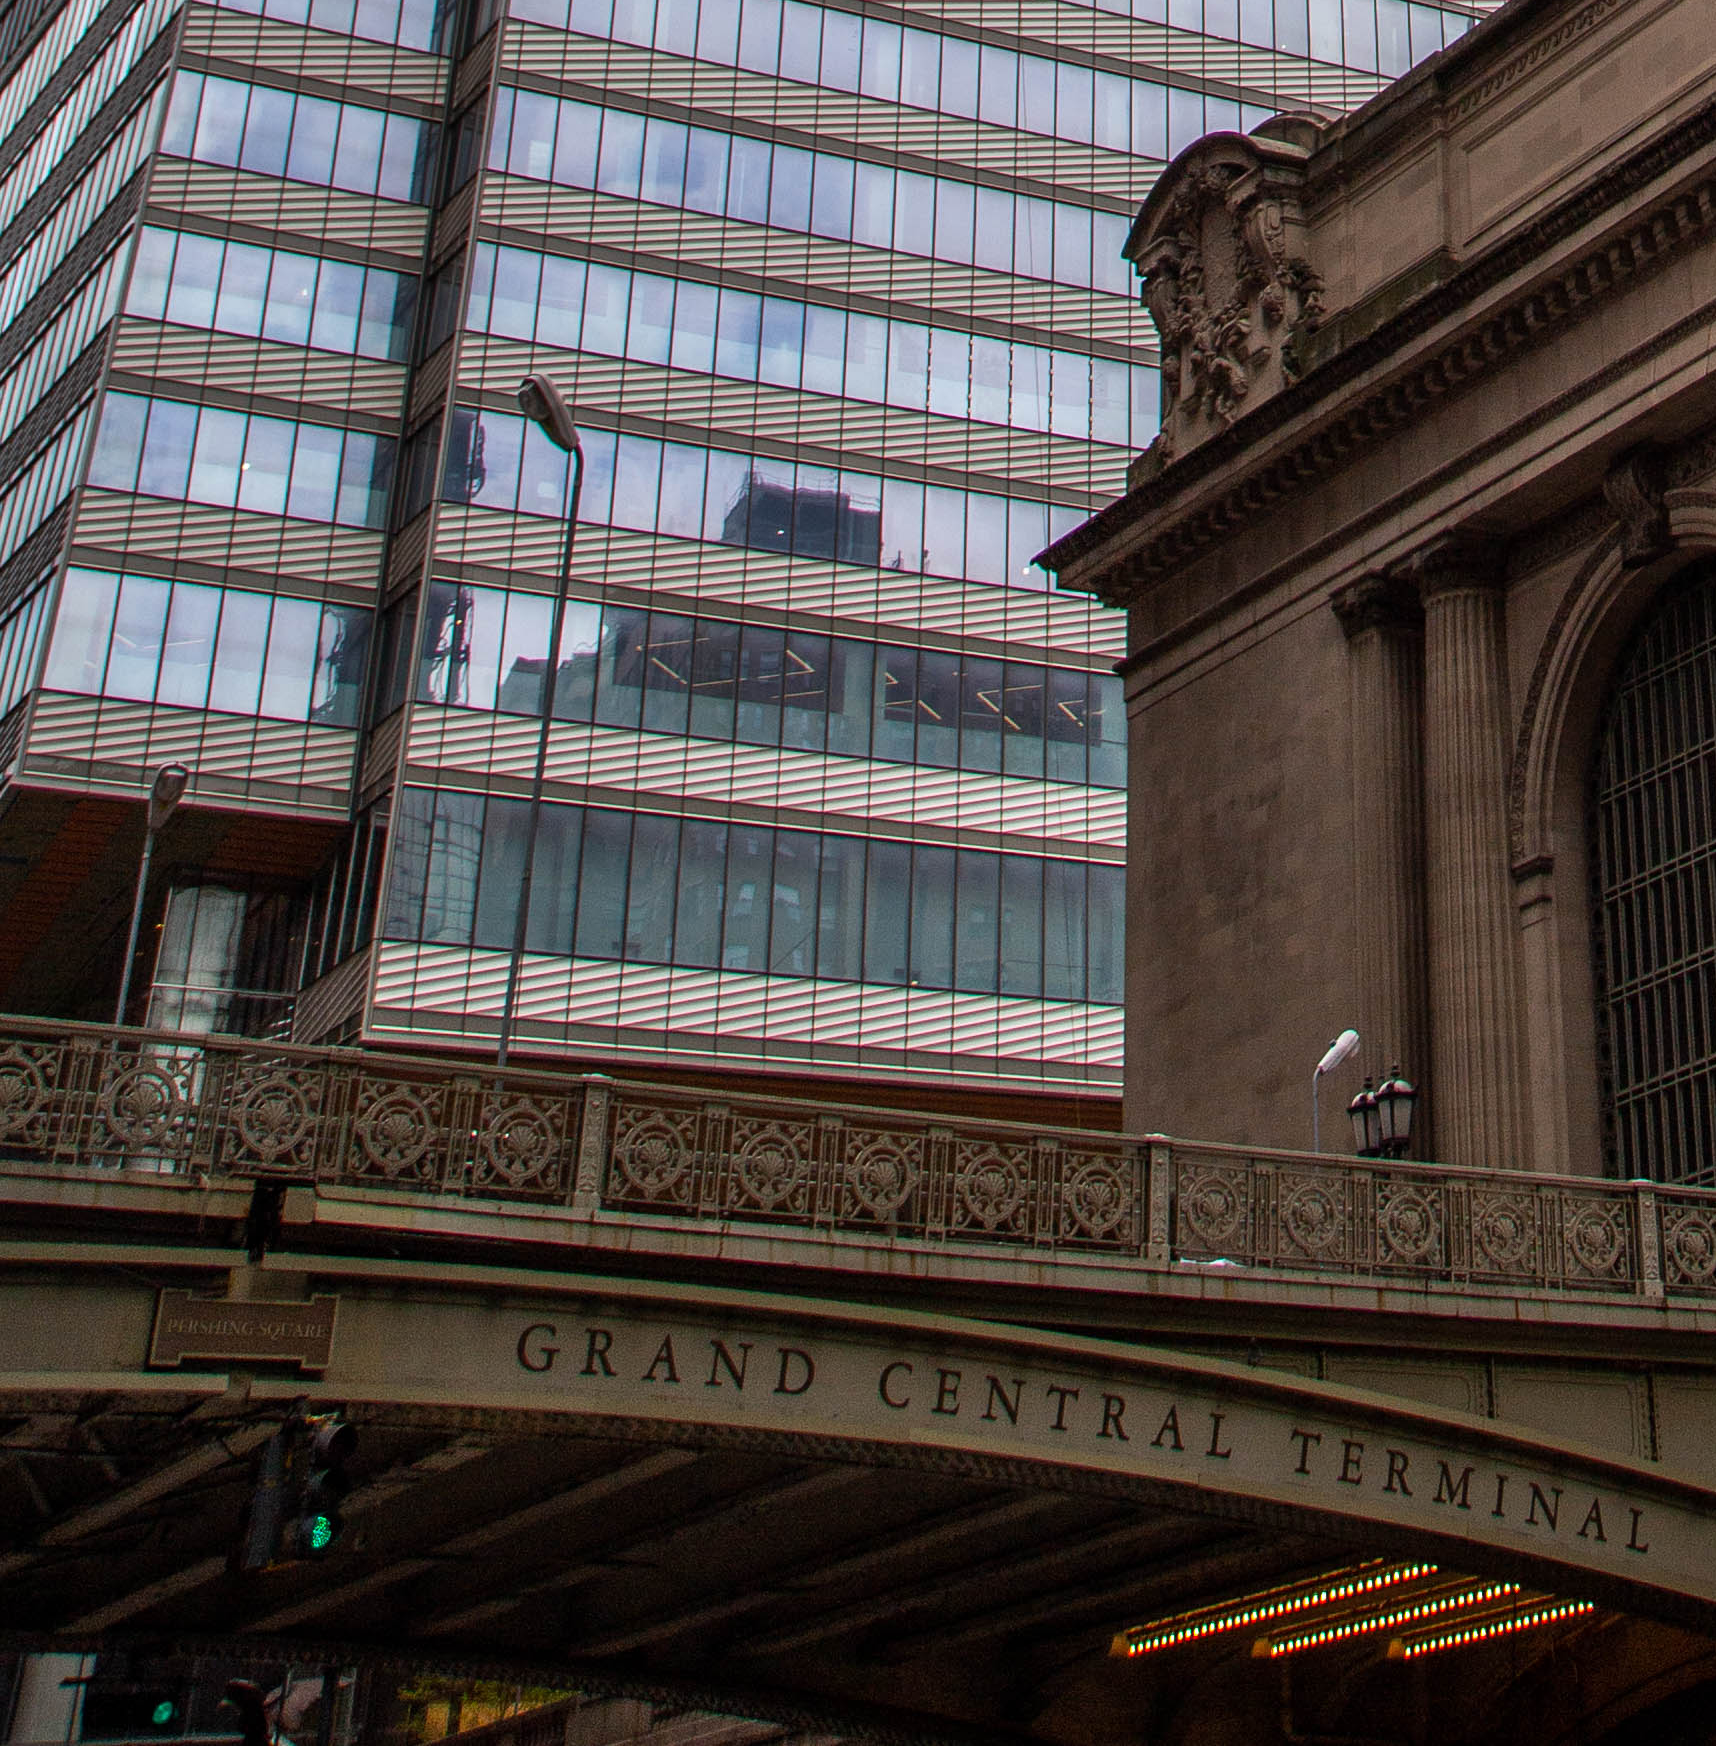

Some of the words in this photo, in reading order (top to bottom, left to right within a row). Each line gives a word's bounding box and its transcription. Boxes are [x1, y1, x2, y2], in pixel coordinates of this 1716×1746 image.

[166, 1317, 255, 1336] PERSHING
[259, 1322, 329, 1340] SQUARE
[517, 1322, 817, 1396] GRAND
[877, 1361, 1232, 1459] CENTRAL
[1290, 1428, 1651, 1555] TERMINAL
